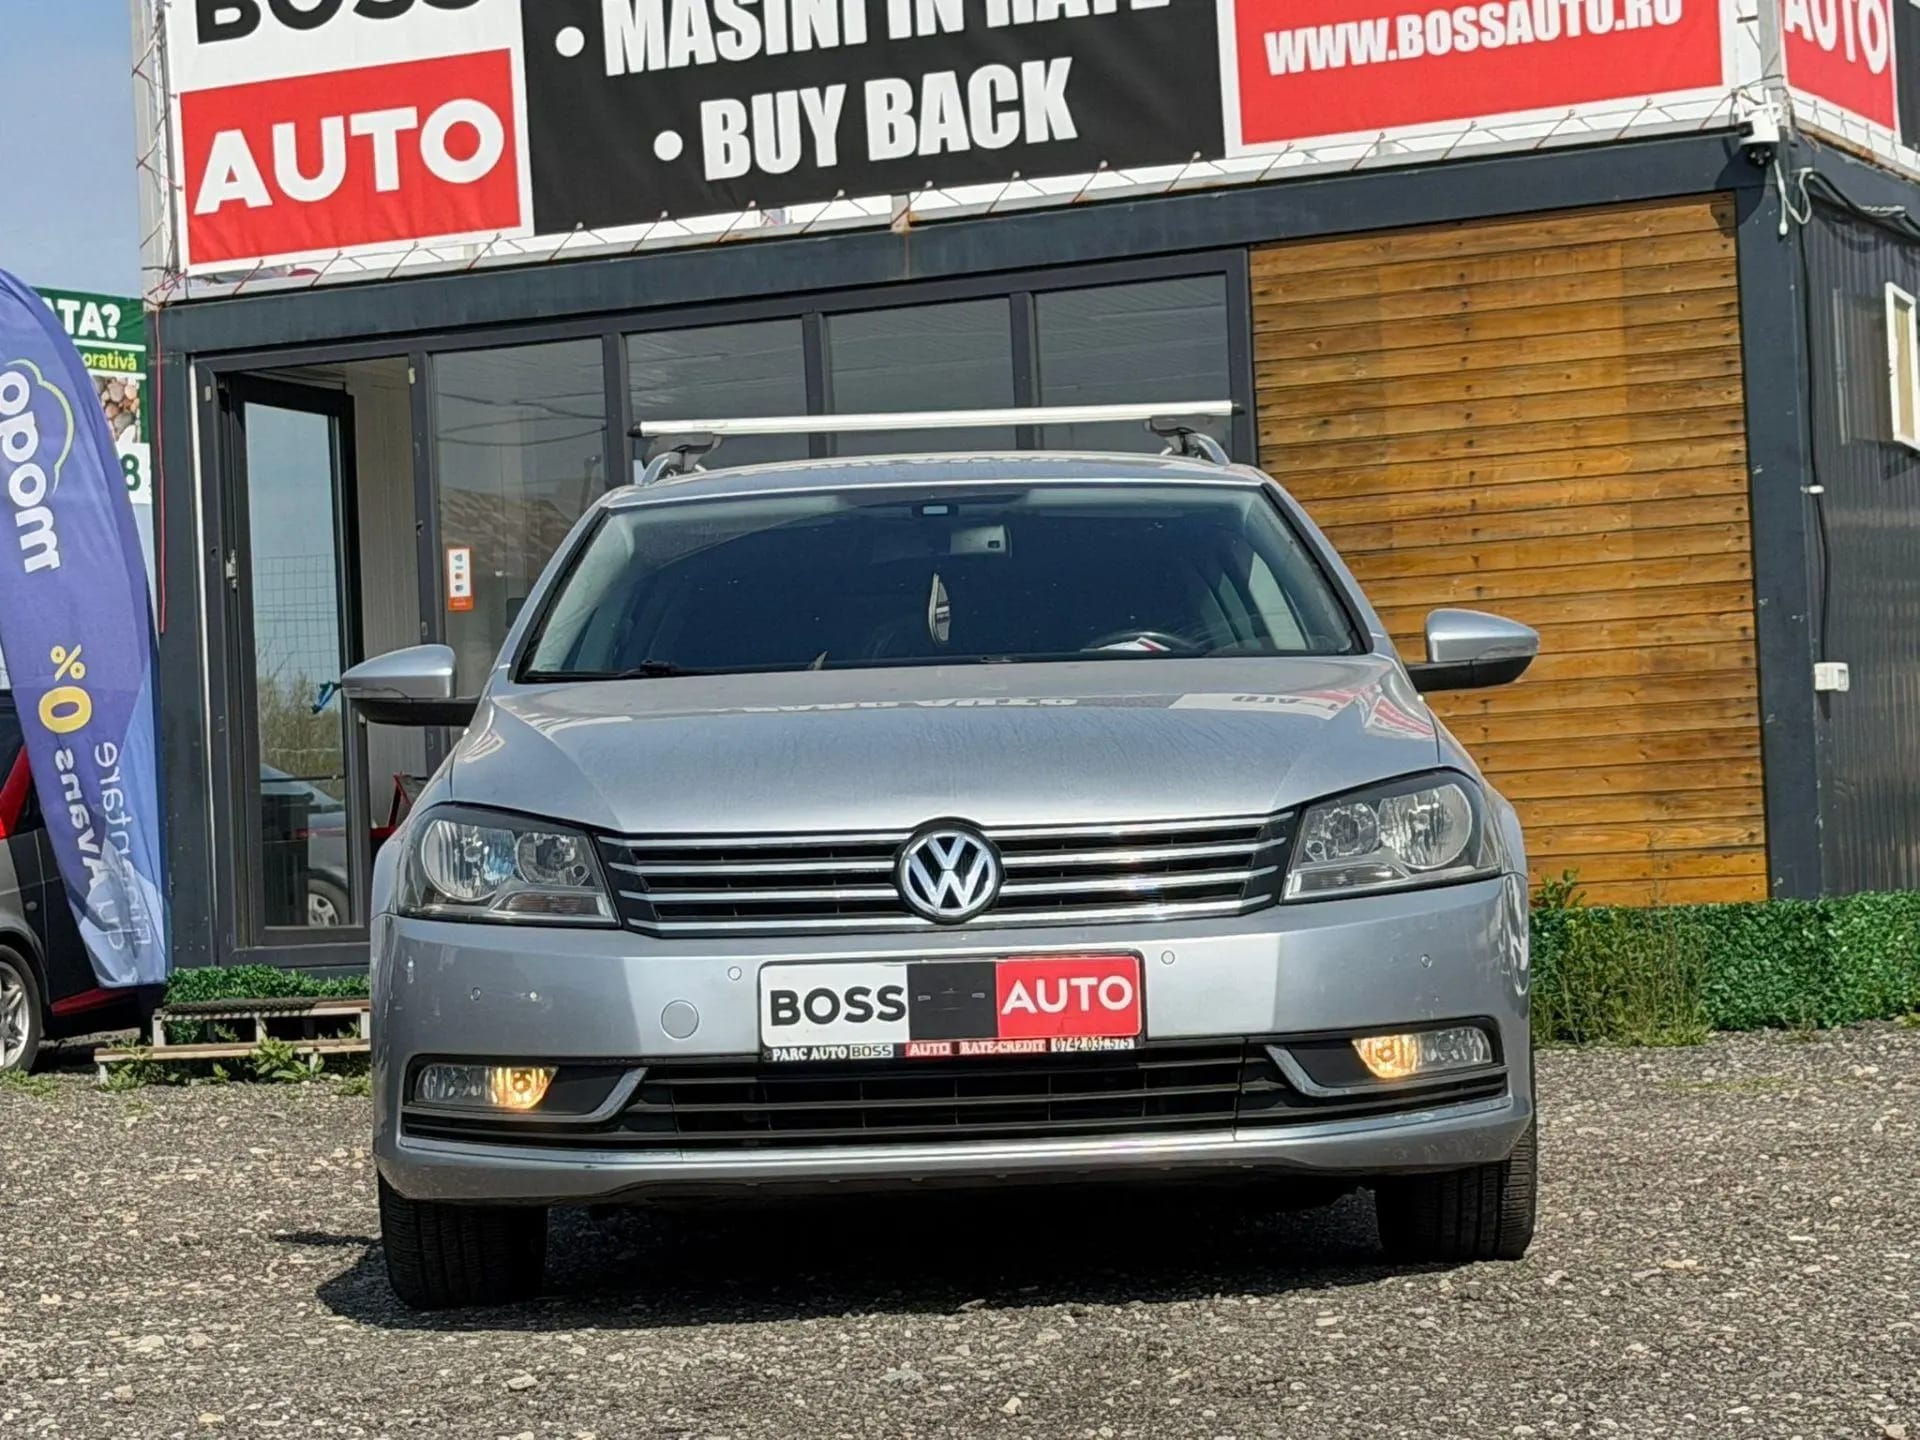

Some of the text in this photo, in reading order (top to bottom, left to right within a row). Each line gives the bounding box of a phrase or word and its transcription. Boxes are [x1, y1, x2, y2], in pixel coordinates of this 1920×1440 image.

[602, 0, 868, 76] MASINI
[1264, 0, 1682, 76] WWW.BOSSAUTO.RO
[701, 57, 1079, 181] BUY BACK
[194, 98, 505, 215] AUTO
[43, 297, 121, 339] TA?
[769, 985, 907, 1026] BOSS
[1001, 975, 1133, 1014] AUTO
[772, 1044, 893, 1062] PARC AUTO BOSS
[909, 1042, 951, 1056] AUTO
